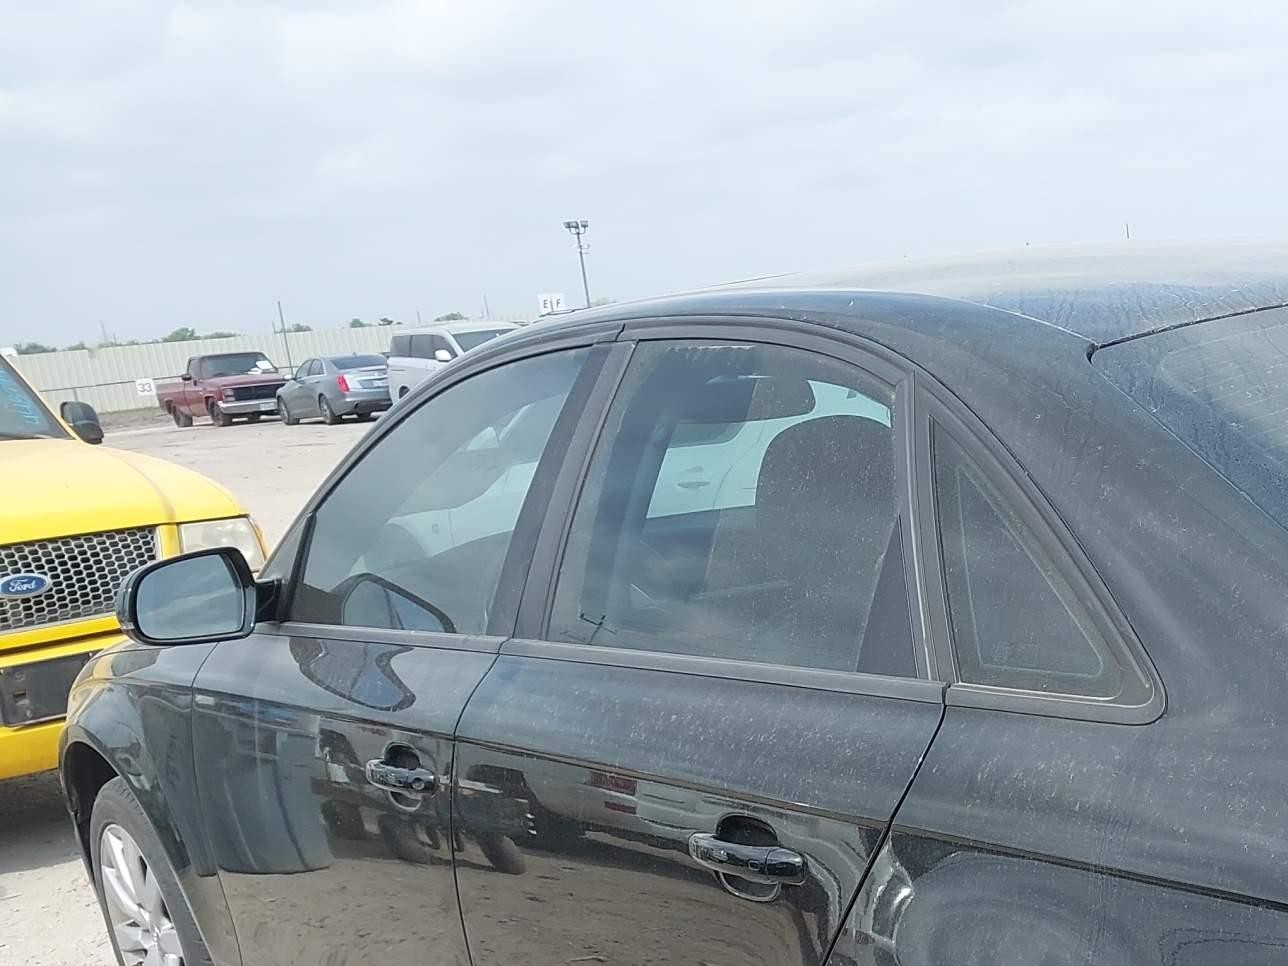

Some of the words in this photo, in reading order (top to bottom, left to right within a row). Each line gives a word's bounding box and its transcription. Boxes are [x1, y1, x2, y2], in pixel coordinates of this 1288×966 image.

[543, 299, 549, 309] E
[556, 298, 561, 309] F
[138, 382, 152, 393] 33
[8, 578, 36, 592] Ford
